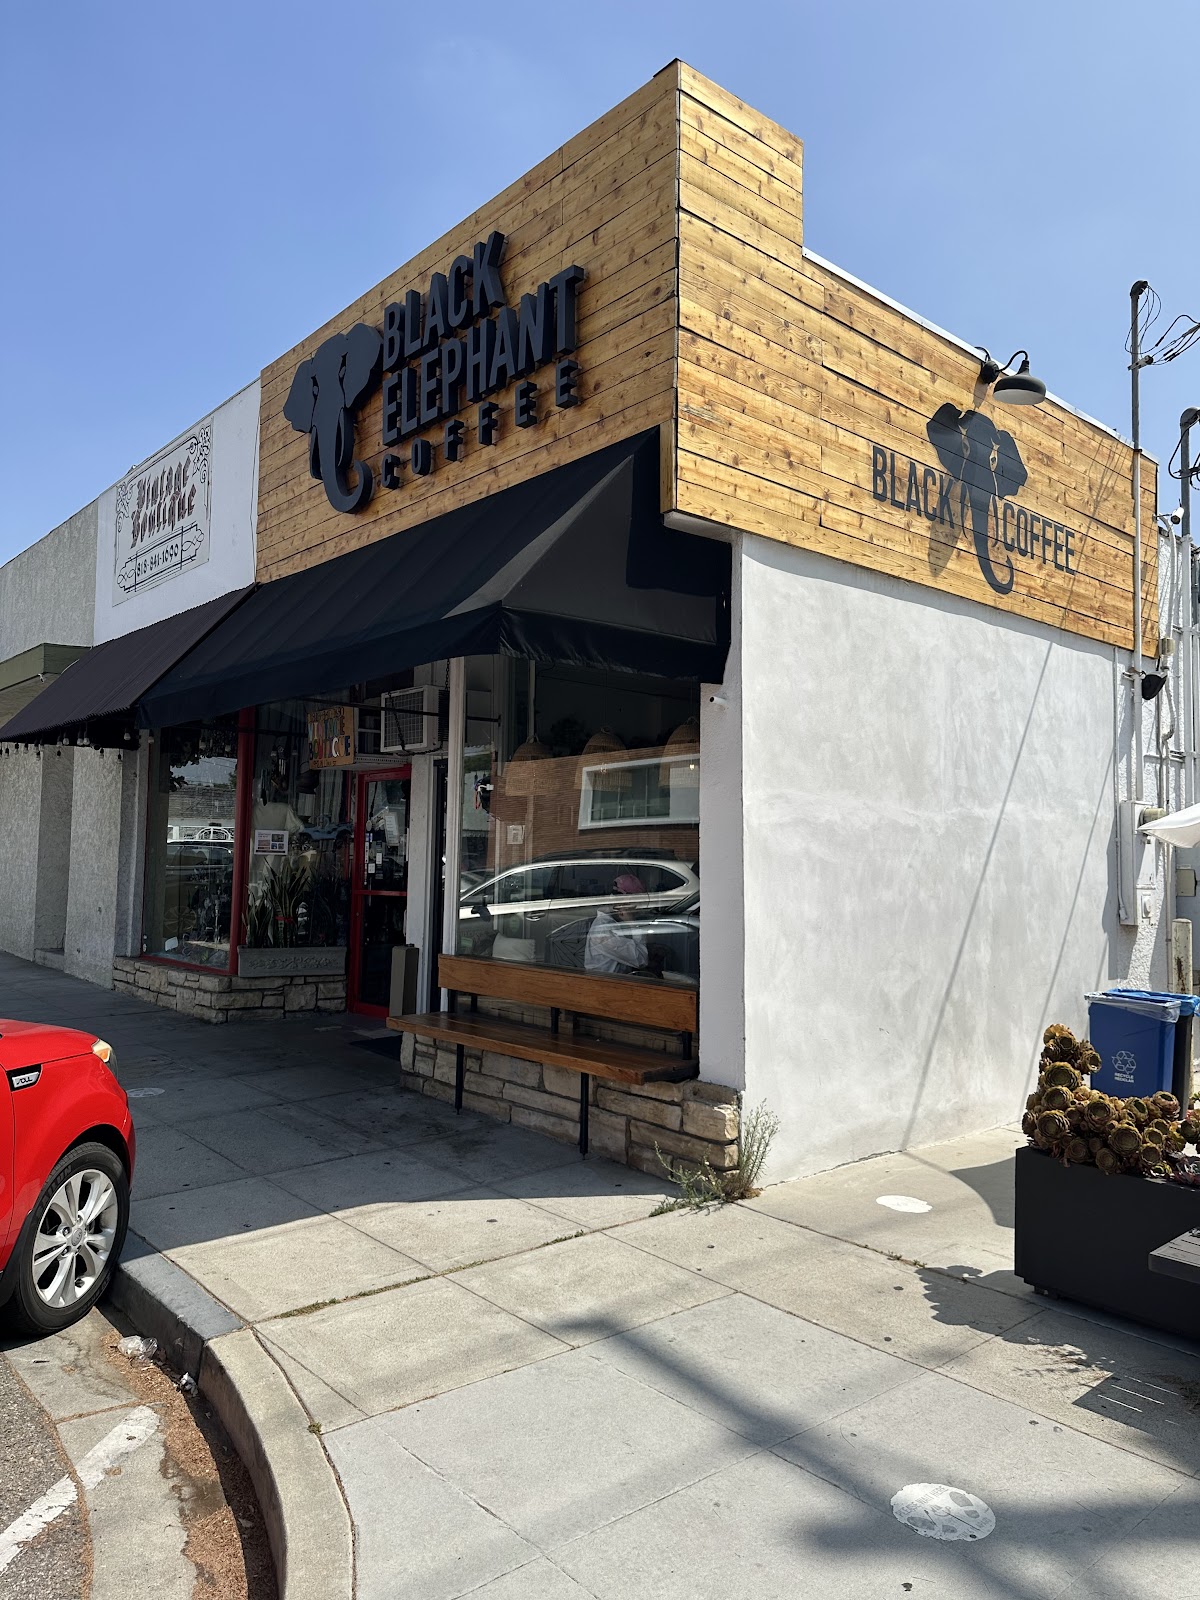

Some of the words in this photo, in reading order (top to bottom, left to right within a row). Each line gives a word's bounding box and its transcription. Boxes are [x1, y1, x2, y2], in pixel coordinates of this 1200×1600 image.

[382, 264, 585, 447] ELEPHANT
[383, 230, 505, 373] BLACK
[381, 358, 579, 490] COFFEE
[872, 445, 957, 529] BLACK
[1002, 502, 1076, 576] COFFEE
